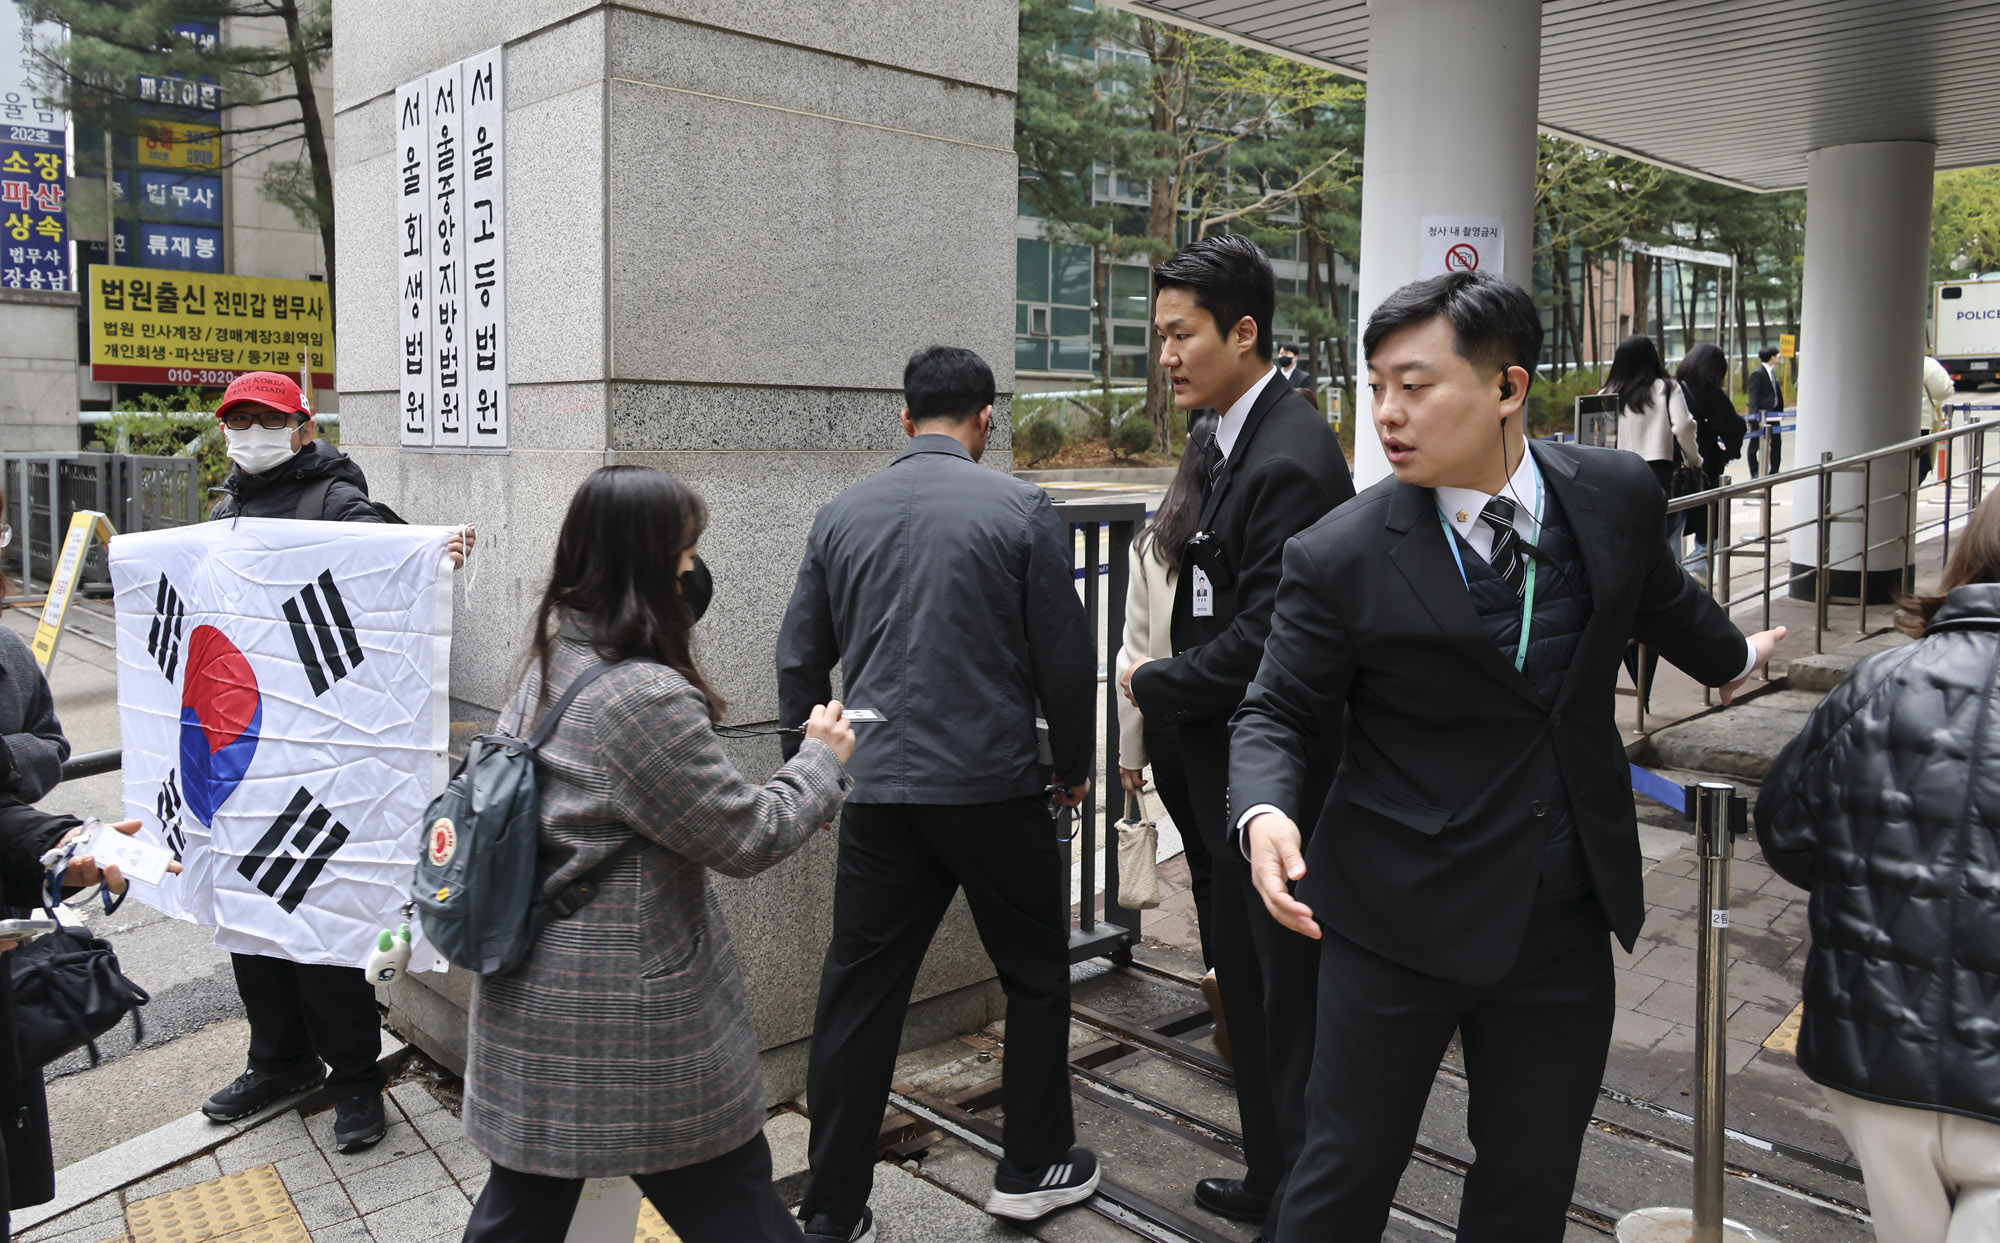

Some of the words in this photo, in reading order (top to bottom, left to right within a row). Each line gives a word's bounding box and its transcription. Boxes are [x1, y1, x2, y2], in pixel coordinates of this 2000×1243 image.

[10, 128, 50, 143] 202호
[2, 150, 62, 181] 소장
[1, 180, 64, 212] 파산
[146, 183, 214, 209] 법무사
[4, 213, 63, 242] 상속
[1428, 226, 1447, 237] 청사
[1450, 226, 1460, 237] 내
[1462, 226, 1498, 238] 촬영금지
[9, 247, 61, 266] 법무사
[147, 234, 216, 259] 류재봉
[3, 267, 67, 291] 장용남
[101, 279, 206, 316] 법원출신
[214, 291, 267, 318] 전민갑
[272, 295, 323, 322] 법무사
[103, 321, 134, 338] 법원
[254, 377, 286, 387] KOREA
[254, 385, 286, 396] AGAIN
